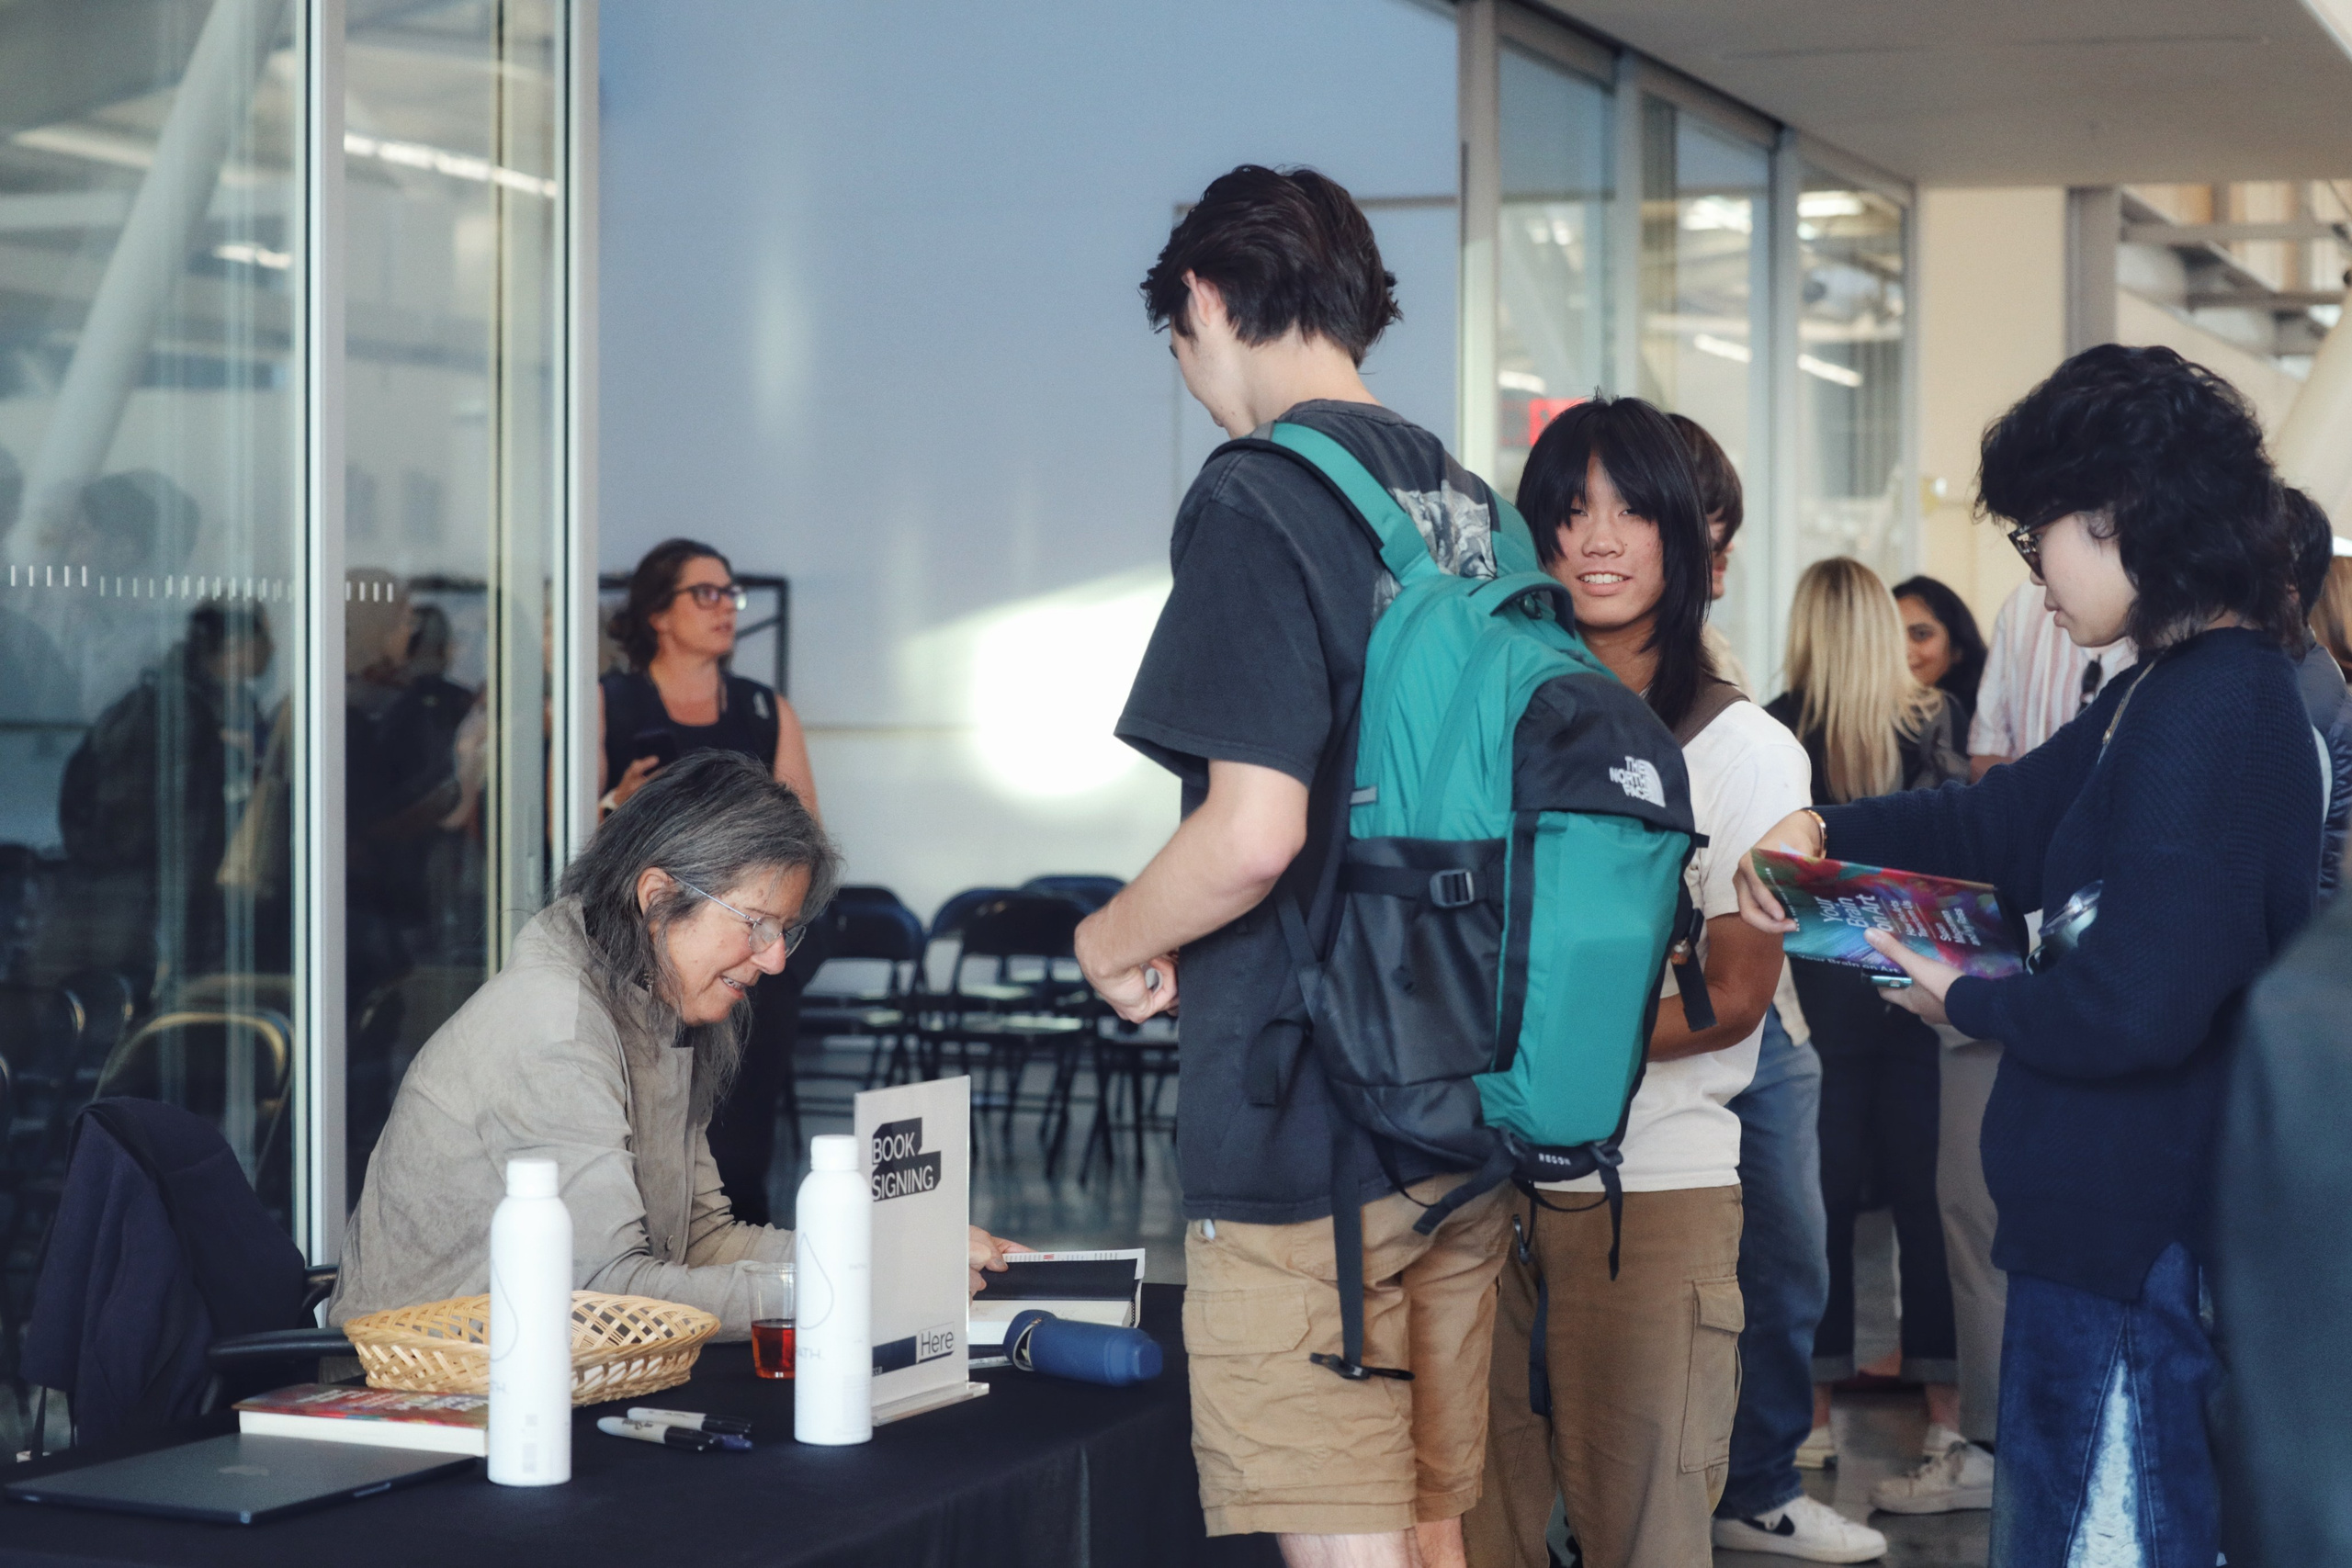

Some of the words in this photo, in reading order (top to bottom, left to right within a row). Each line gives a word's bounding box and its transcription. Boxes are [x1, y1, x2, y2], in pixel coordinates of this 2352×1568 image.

[1624, 755, 1645, 773] THE
[1609, 766, 1646, 788] NORTH
[1622, 783, 1651, 800] FACE
[1814, 896, 1843, 923] Your
[1838, 897, 1870, 928] Brain
[1855, 894, 1884, 917] Art
[1872, 916, 1894, 933] on
[1826, 957, 1860, 969] Brain
[1880, 964, 1903, 975] Art
[873, 1131, 916, 1165] BOOK
[872, 1164, 934, 1201] SIGNING
[921, 1330, 955, 1357] Here
